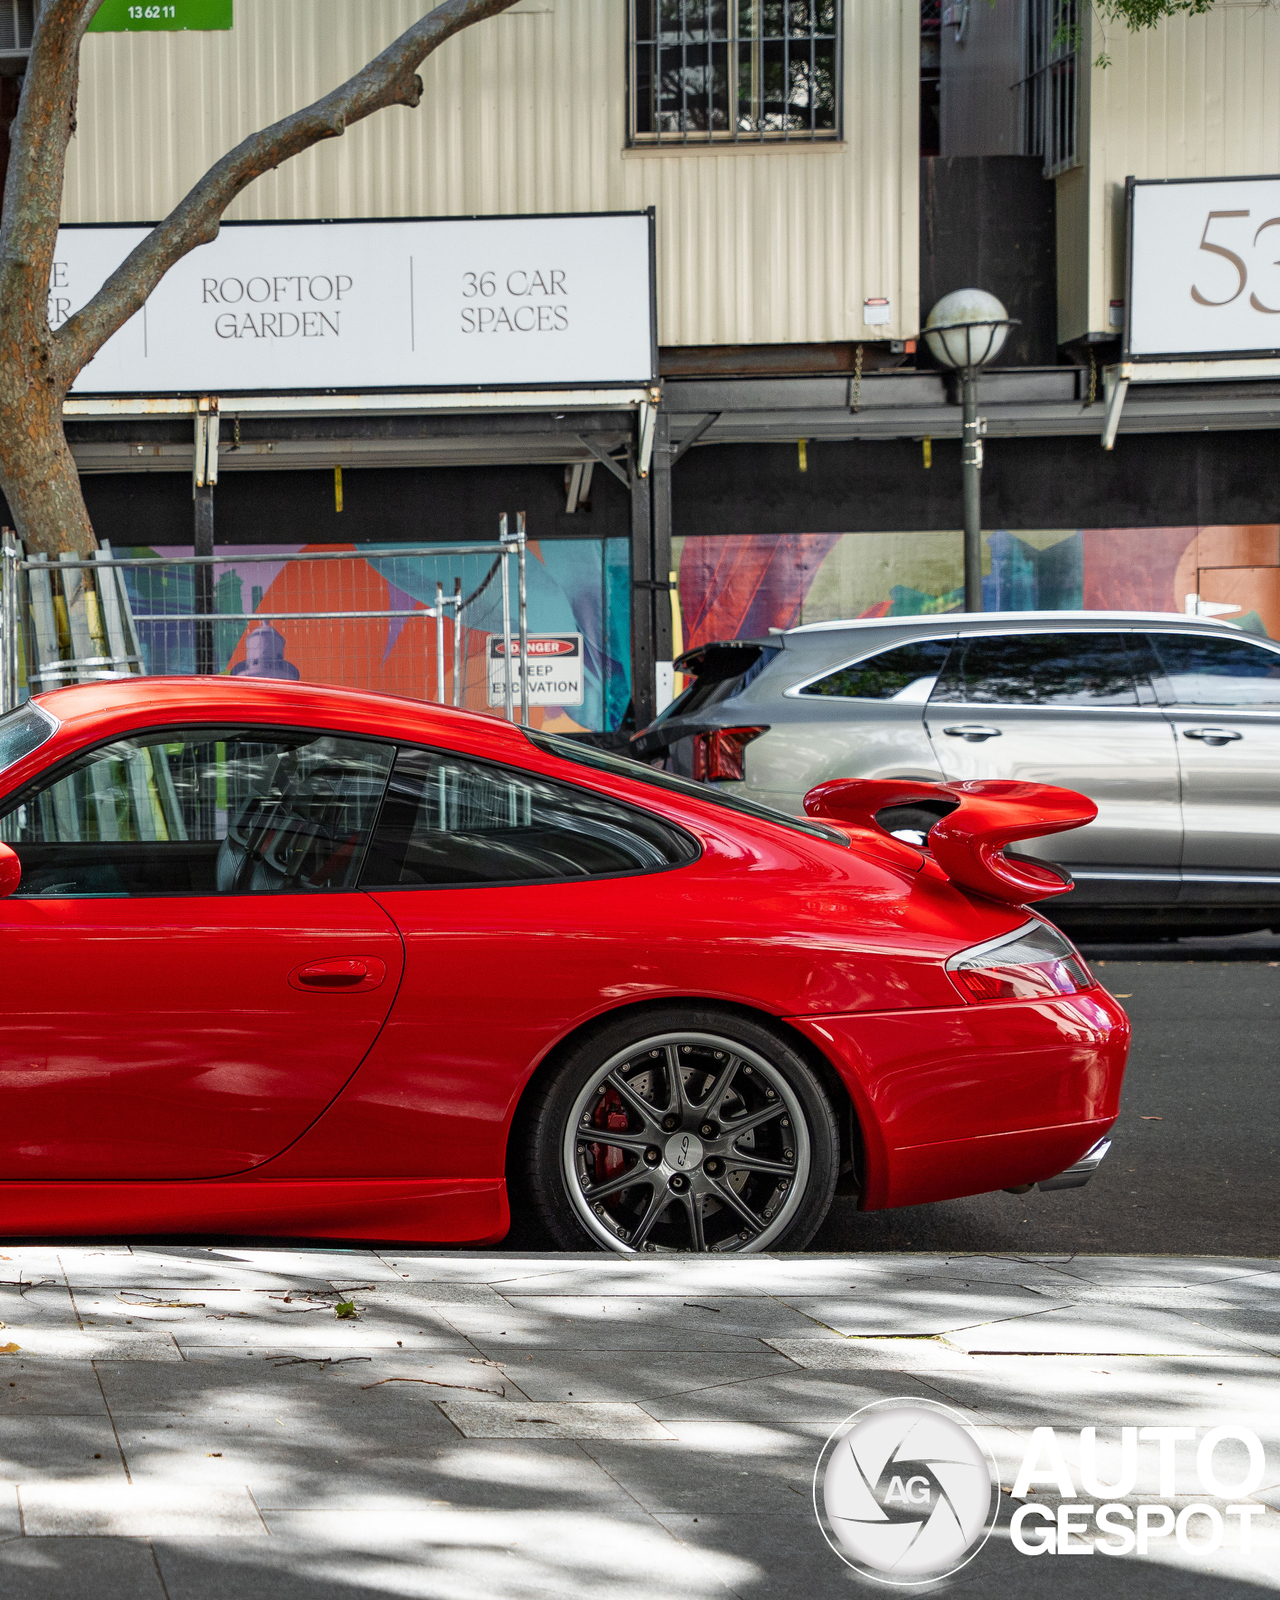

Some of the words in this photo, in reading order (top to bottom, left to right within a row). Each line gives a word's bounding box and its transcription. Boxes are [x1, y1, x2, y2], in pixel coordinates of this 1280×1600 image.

[201, 274, 353, 303] ROOFTOP
[462, 270, 497, 298] 36
[506, 269, 569, 297] CAR
[214, 311, 341, 339] GARDEN
[460, 304, 569, 334] SPACES
[511, 642, 560, 653] DNGER
[519, 665, 553, 677] EEP
[492, 681, 578, 694] ECVATION
